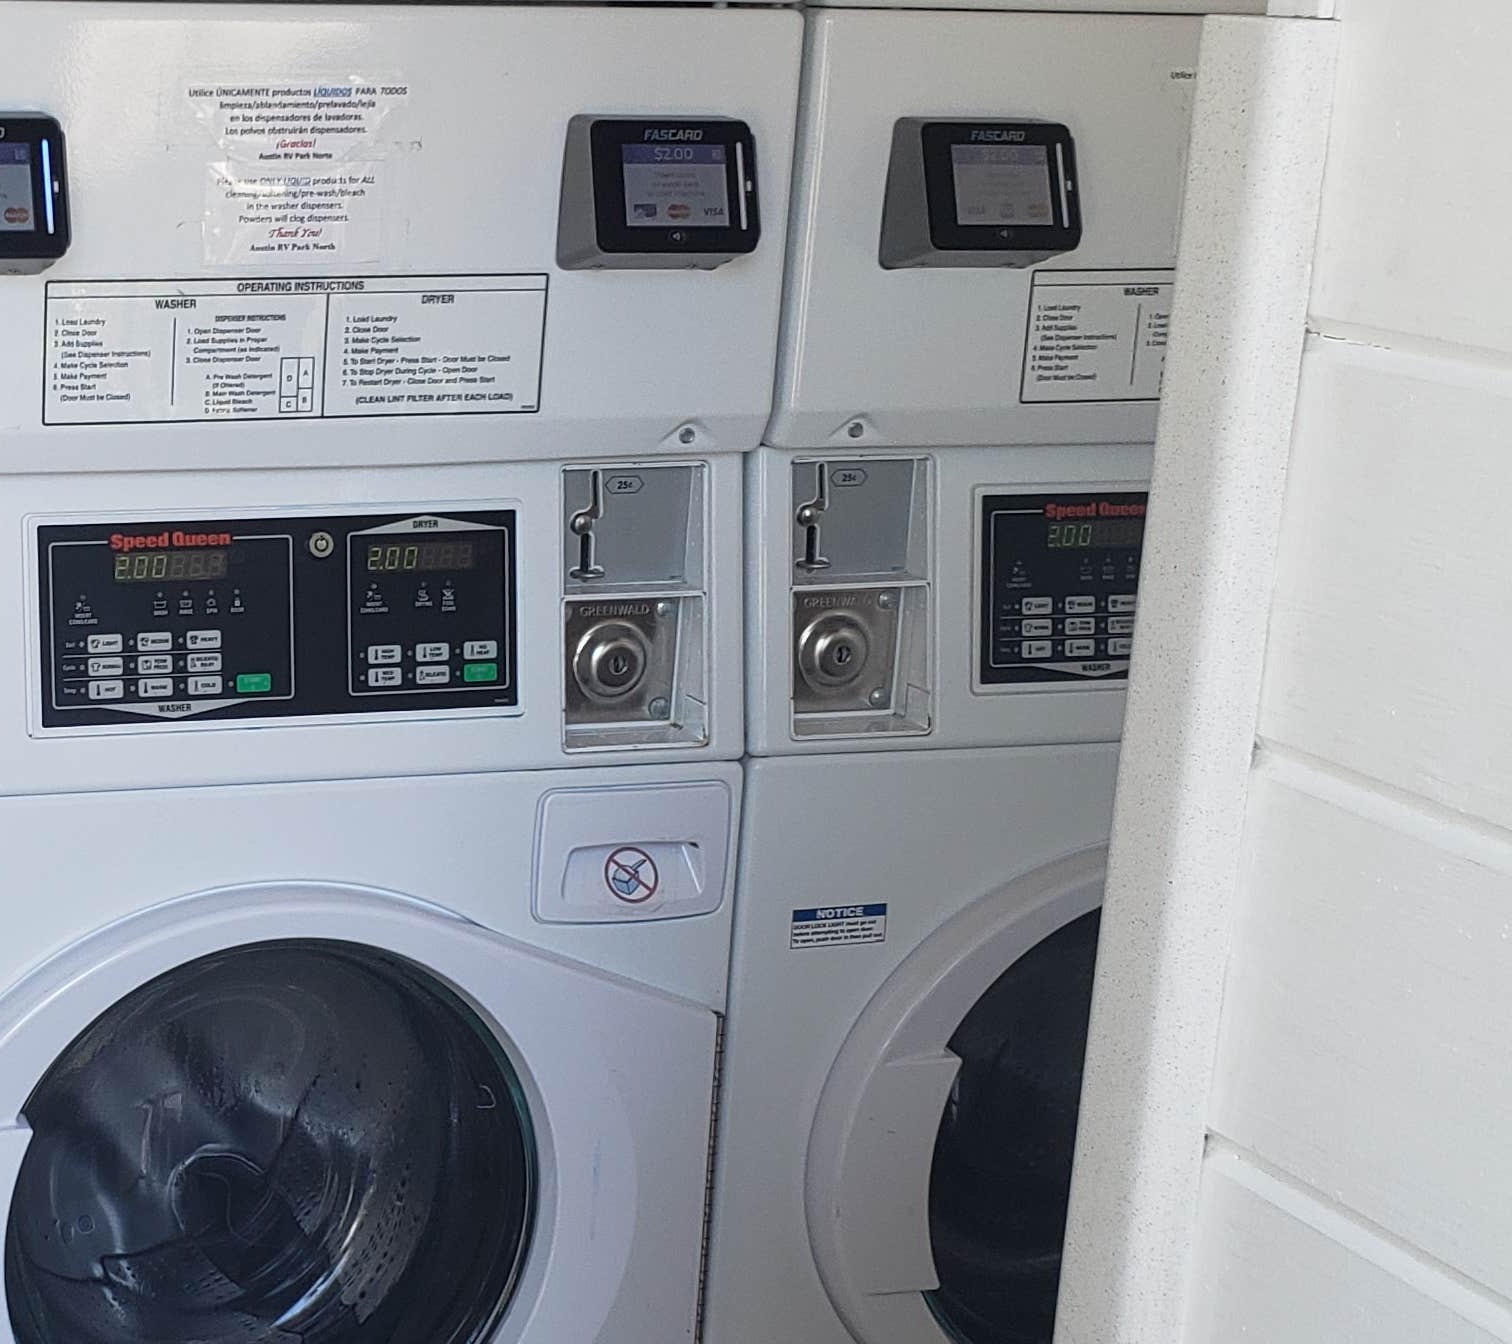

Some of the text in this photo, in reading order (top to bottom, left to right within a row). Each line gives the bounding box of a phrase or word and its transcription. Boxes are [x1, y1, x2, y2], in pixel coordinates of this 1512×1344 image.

[189, 88, 213, 96] Utilice
[216, 88, 269, 96] ÚNICAMENTE
[272, 88, 311, 97] productos
[242, 114, 253, 122] los
[255, 114, 310, 123] dispensadores
[240, 128, 265, 136] polvos
[644, 129, 703, 141] FASCARD
[970, 130, 1026, 142] FASCARD
[276, 140, 316, 150] ¡Gracias!
[654, 148, 693, 160] $2.00
[313, 177, 346, 186] products
[703, 207, 724, 216] VISA
[289, 215, 305, 223] clog
[269, 227, 322, 238] Thank You!
[237, 281, 365, 292] OPERATING INSTRUCTIONS
[155, 299, 197, 309] WASHER
[421, 295, 455, 304] DRYER
[371, 316, 397, 324] Laundry
[371, 336, 389, 344] Cycle
[370, 347, 399, 355] Payment
[356, 396, 385, 404] (CLEAN
[387, 395, 404, 403] LINT
[436, 394, 462, 402] AFTER
[488, 393, 513, 401] LOAD)
[617, 480, 634, 490] 25¢
[1045, 503, 1097, 520] Speed
[412, 520, 439, 529] DRYER
[110, 531, 231, 552] Speed Queen
[367, 546, 418, 570] 2.00
[115, 556, 168, 580] 2.00
[803, 590, 874, 609] GREENWAD
[578, 604, 650, 617] GREENWALD
[158, 703, 192, 713] WASHER
[816, 906, 864, 919] NOTICE
